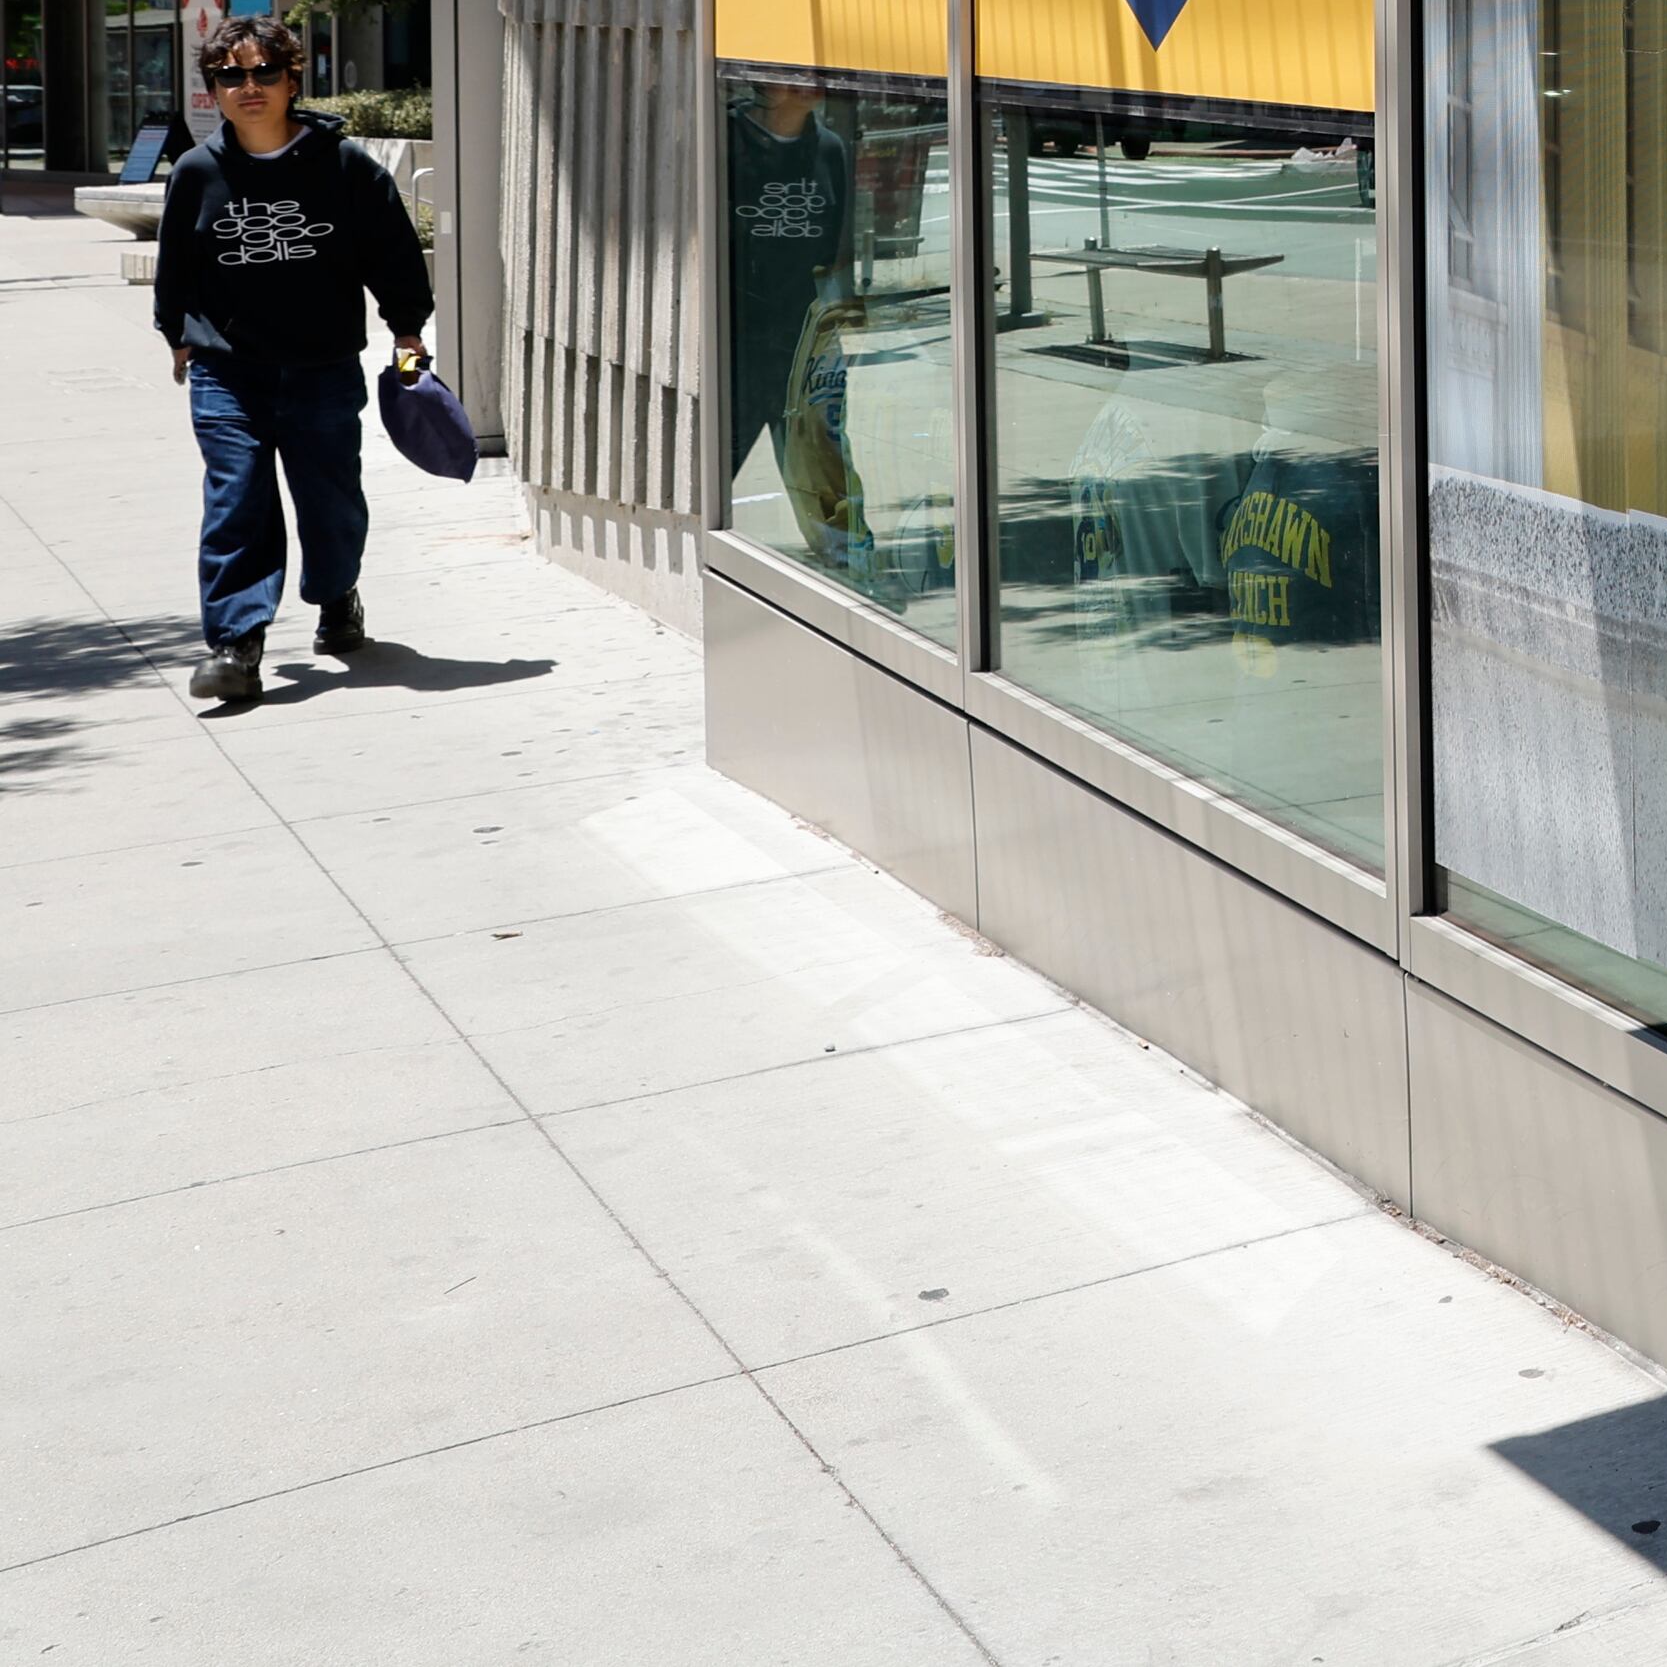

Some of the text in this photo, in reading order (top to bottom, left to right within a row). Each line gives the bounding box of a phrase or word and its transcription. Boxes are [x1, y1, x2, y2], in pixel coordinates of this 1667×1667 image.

[223, 197, 301, 218] the
[212, 213, 307, 240] goo
[241, 223, 335, 251] goo
[217, 240, 318, 266] dolls
[1220, 491, 1332, 589] ARSHAWN
